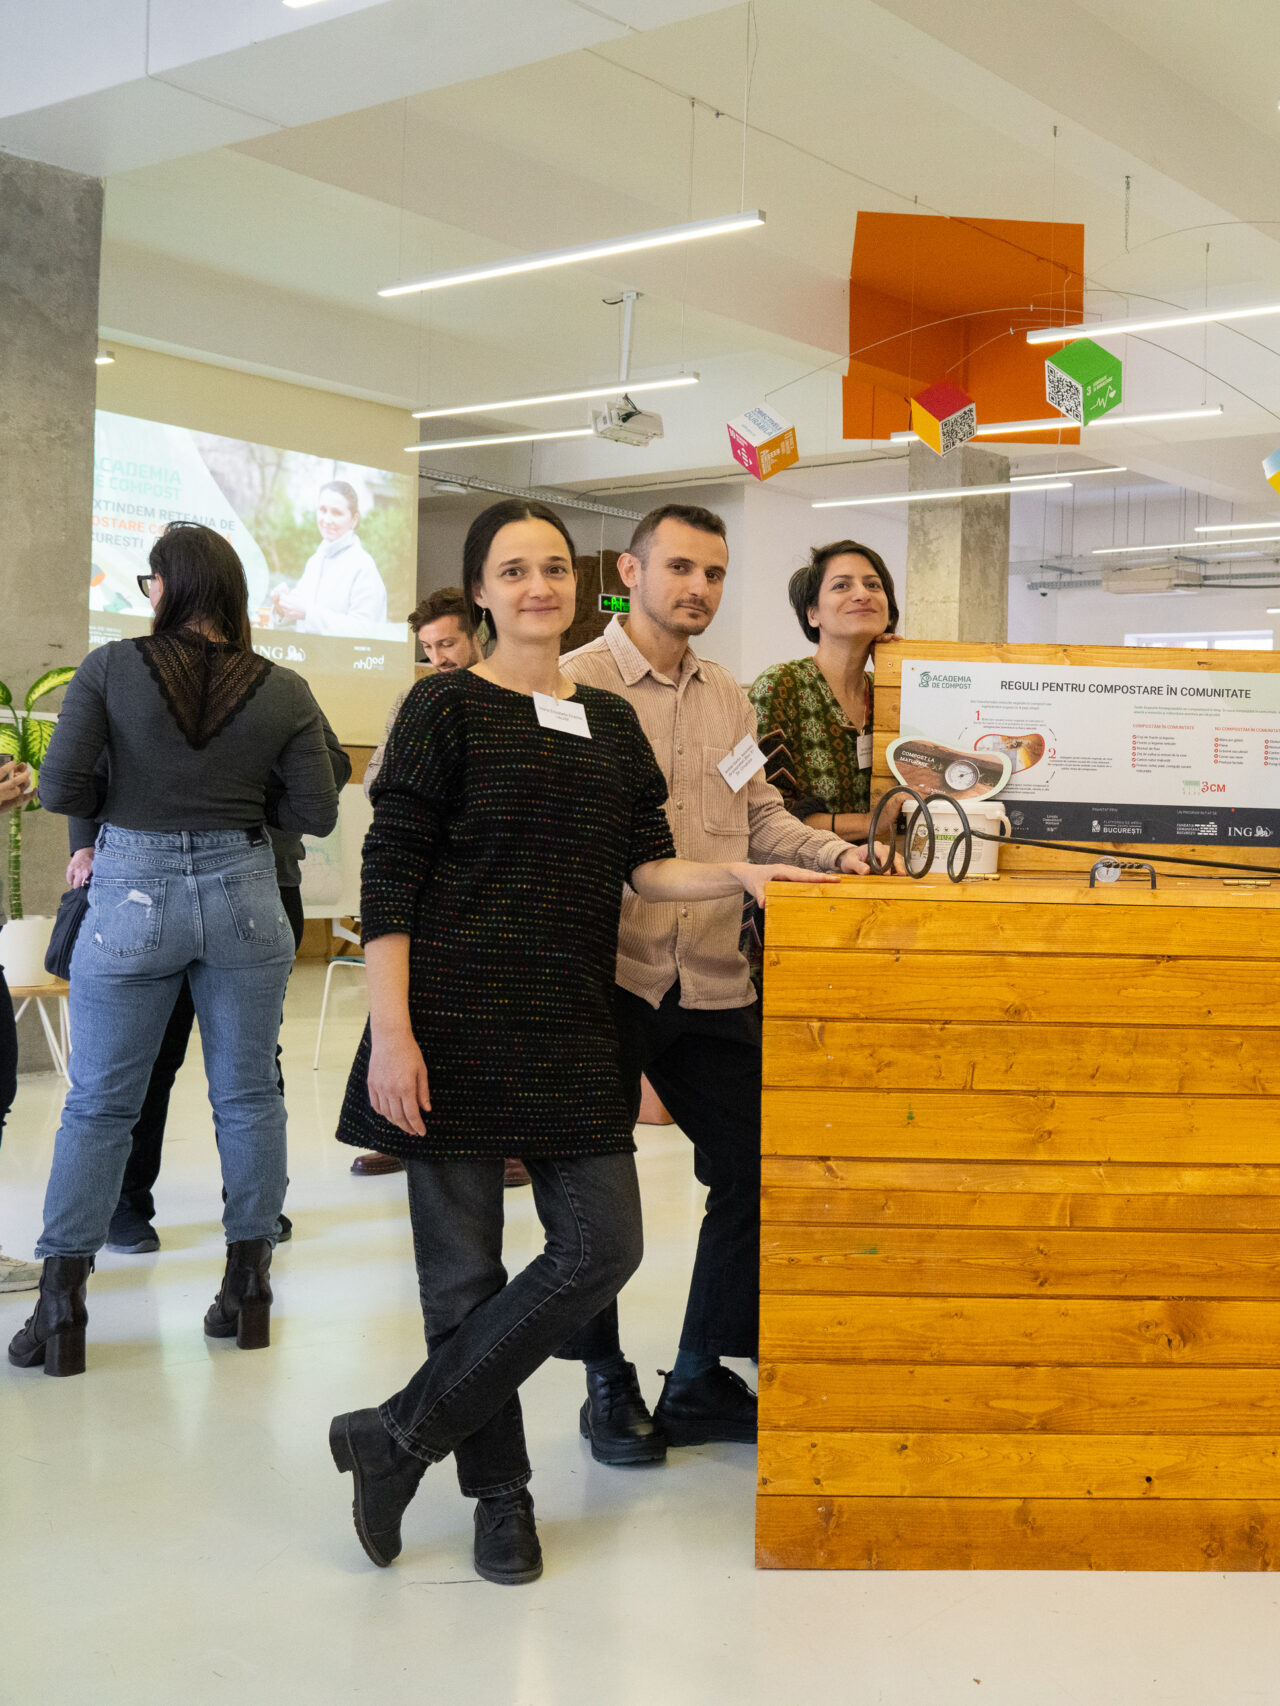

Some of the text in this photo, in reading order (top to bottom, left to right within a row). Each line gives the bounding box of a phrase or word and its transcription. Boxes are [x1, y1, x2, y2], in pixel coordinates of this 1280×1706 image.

[93, 499, 155, 519] XTINDEM
[219, 519, 236, 531] DE
[92, 515, 144, 533] OSTARE
[932, 674, 971, 683] ACADEMIA
[941, 682, 971, 690] COMPOST
[1000, 680, 1252, 699] REGULI PENTRU COMPOSTARE ÎN COMUNITATE
[975, 710, 981, 721] 1
[1048, 748, 1056, 759] 2
[1103, 826, 1142, 835] BUCUREȘTI
[1228, 826, 1252, 837] ING
